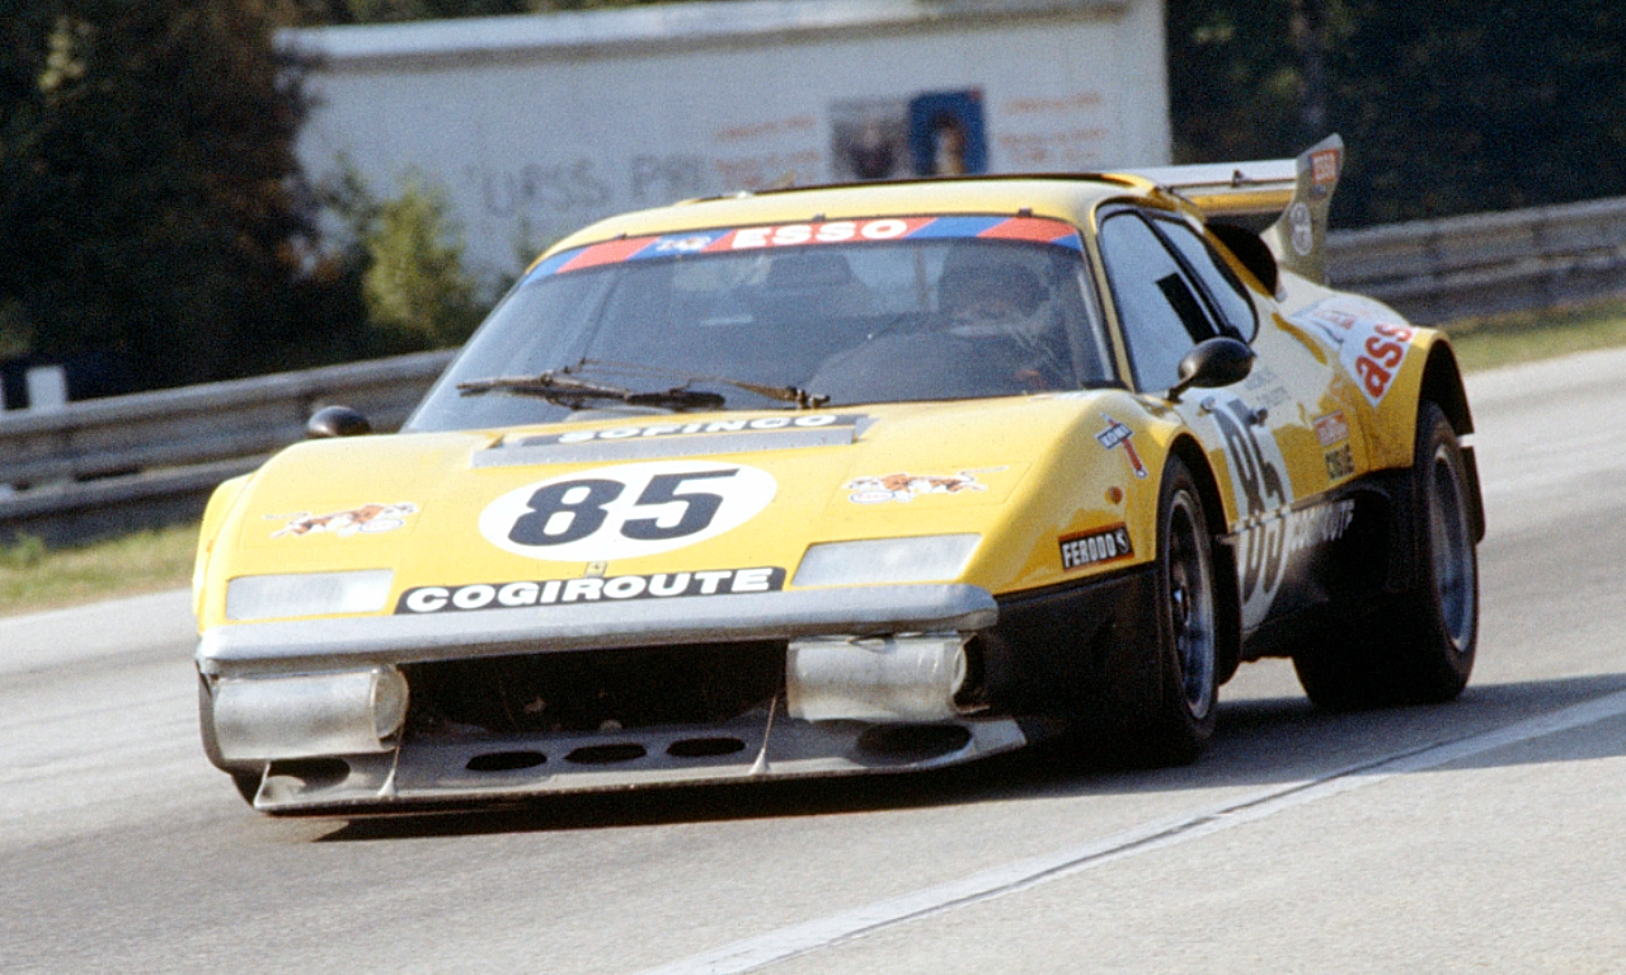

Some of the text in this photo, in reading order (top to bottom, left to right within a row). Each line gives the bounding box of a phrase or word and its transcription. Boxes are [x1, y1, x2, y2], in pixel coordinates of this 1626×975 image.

[731, 218, 908, 250] ESSO
[558, 414, 836, 443] SOFINCO
[508, 468, 739, 547] 85
[1062, 533, 1116, 568] FERODO
[406, 567, 772, 613] COGIROUTE
